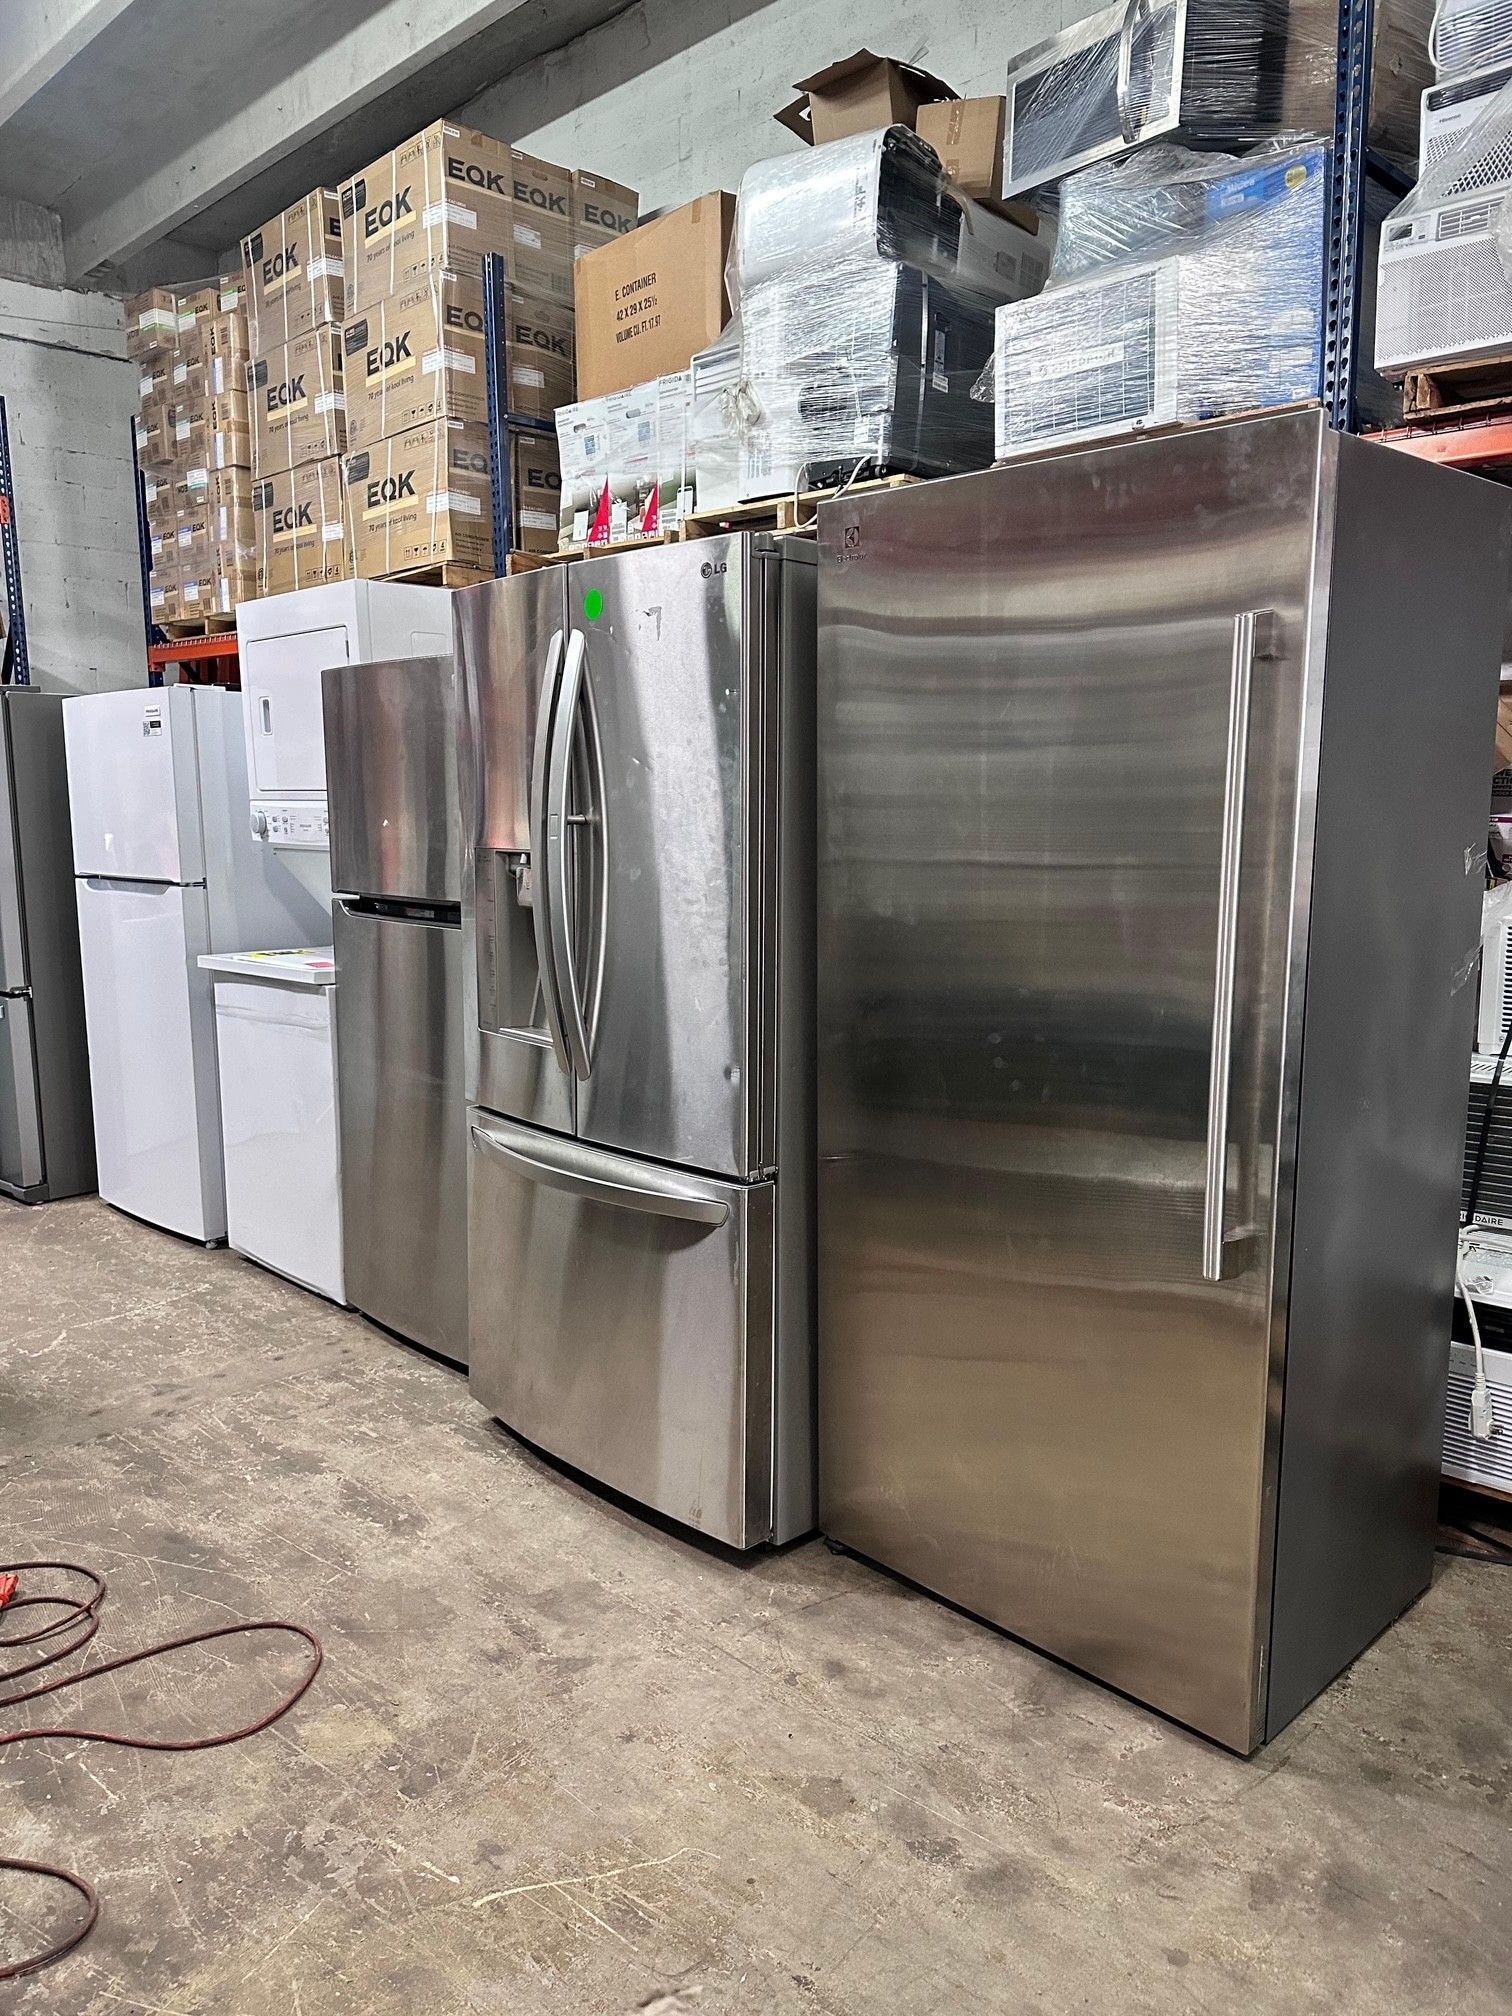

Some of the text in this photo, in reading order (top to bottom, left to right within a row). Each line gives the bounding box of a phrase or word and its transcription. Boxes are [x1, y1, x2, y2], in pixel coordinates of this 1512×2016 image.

[448, 157, 505, 195] EQK
[365, 186, 413, 239] EQK
[514, 180, 566, 215] EQK
[585, 203, 633, 232] EQK
[263, 242, 299, 286] EQK
[622, 272, 657, 298] CONTAINER
[446, 305, 484, 331] EQ
[616, 310, 624, 321] 42
[630, 303, 638, 316] 29
[367, 330, 412, 376] EQK
[515, 325, 568, 357] EQK
[267, 373, 307, 412] EQK
[453, 449, 489, 474] EQ
[368, 469, 416, 509] EQK
[528, 467, 561, 489] EQ
[272, 501, 313, 534] EQK
[713, 562, 728, 575] LG
